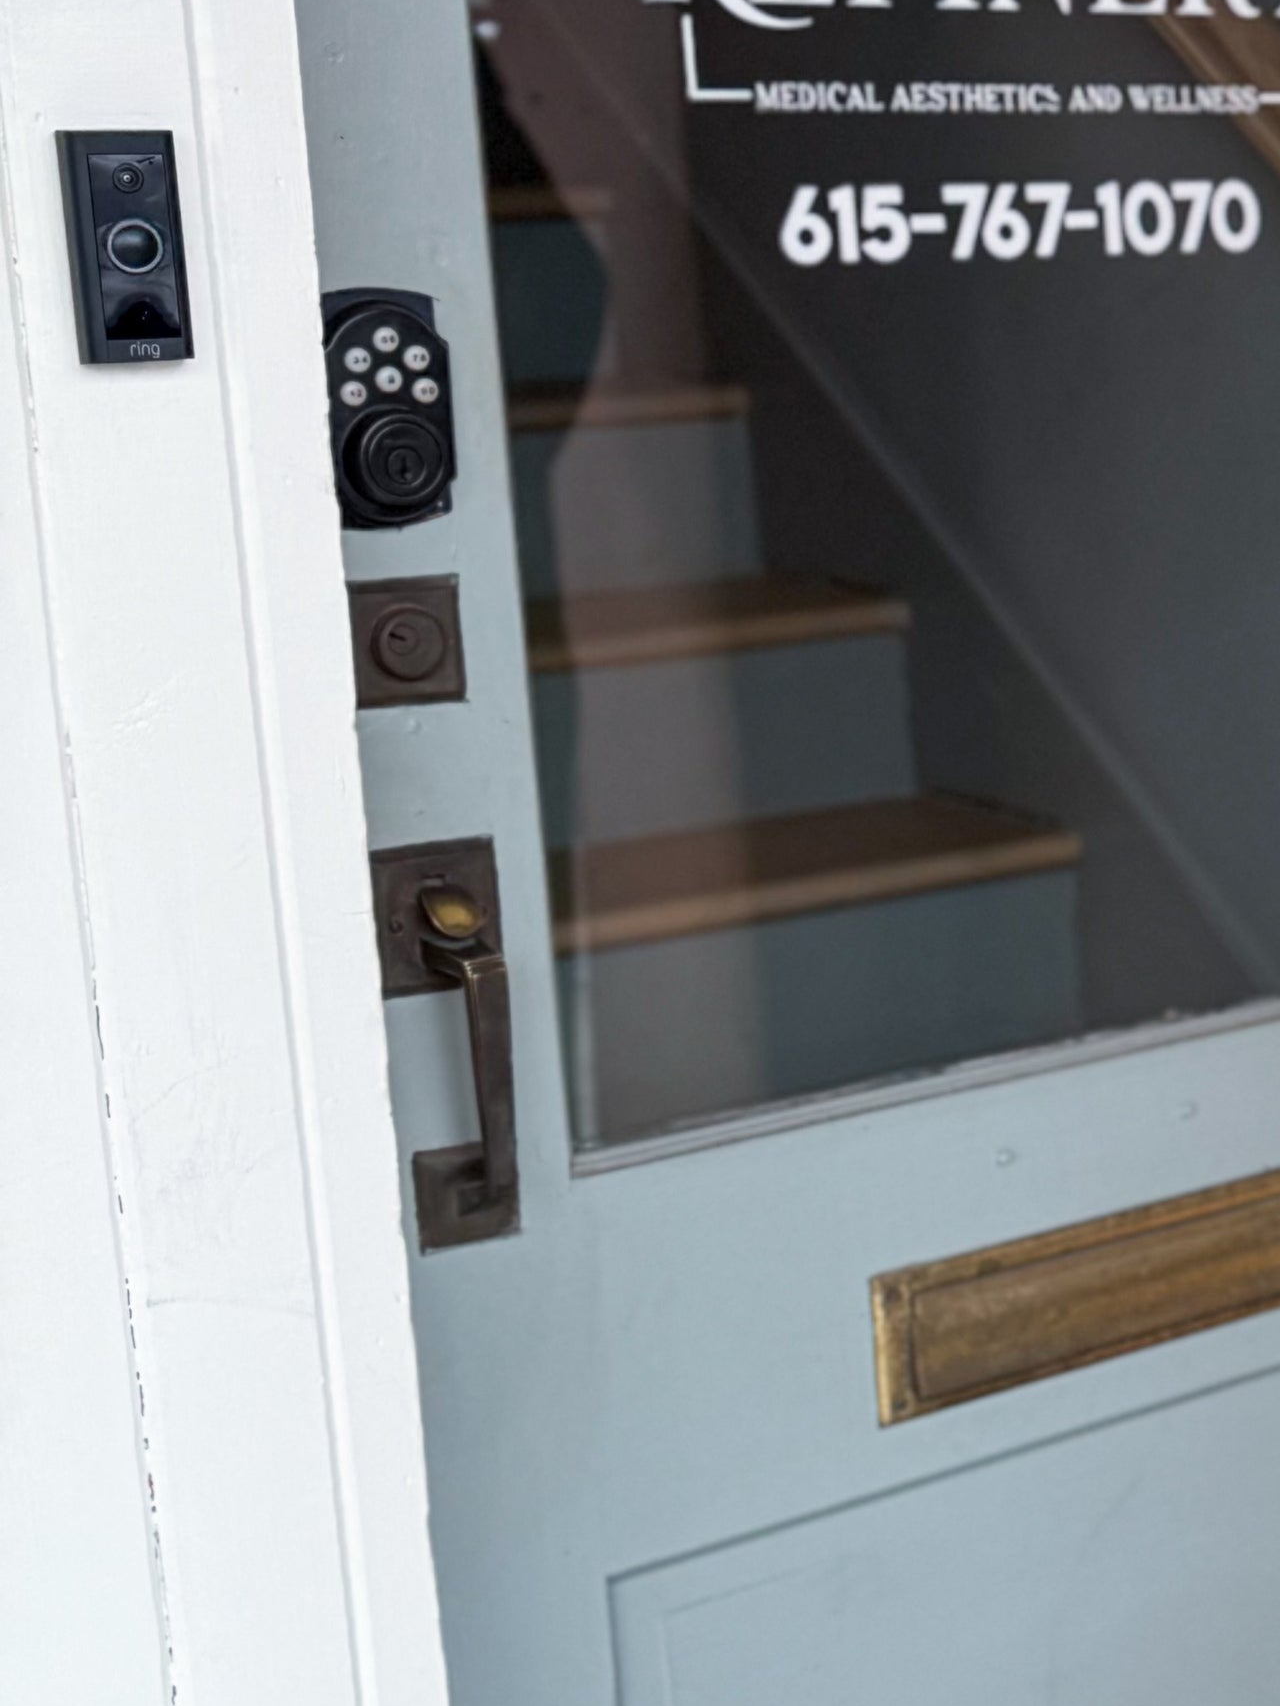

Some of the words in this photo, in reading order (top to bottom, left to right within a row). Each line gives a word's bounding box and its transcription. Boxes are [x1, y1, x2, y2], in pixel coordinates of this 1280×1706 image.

[755, 81, 884, 112] MEDICAL
[890, 82, 1061, 113] AESTHETICS
[1069, 84, 1123, 113] AND
[1128, 84, 1258, 114] WELLNESS
[780, 178, 1261, 266] 615-767-1070
[129, 340, 161, 359] ring
